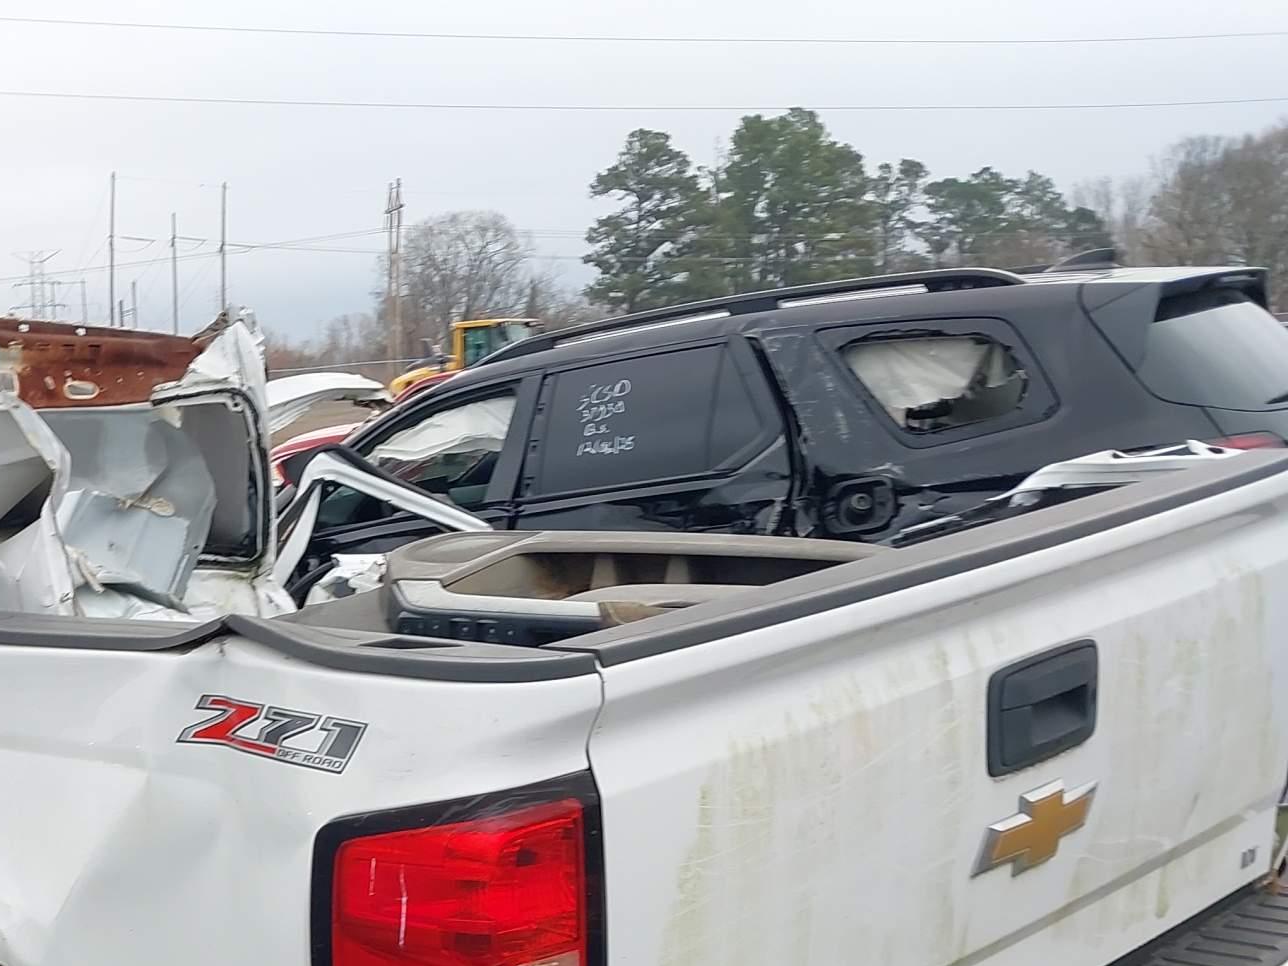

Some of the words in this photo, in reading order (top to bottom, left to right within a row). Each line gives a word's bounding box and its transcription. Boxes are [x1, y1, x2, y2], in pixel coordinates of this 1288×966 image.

[176, 694, 369, 774] Z71
[277, 749, 302, 762] OFF
[302, 755, 344, 770] ROAD
